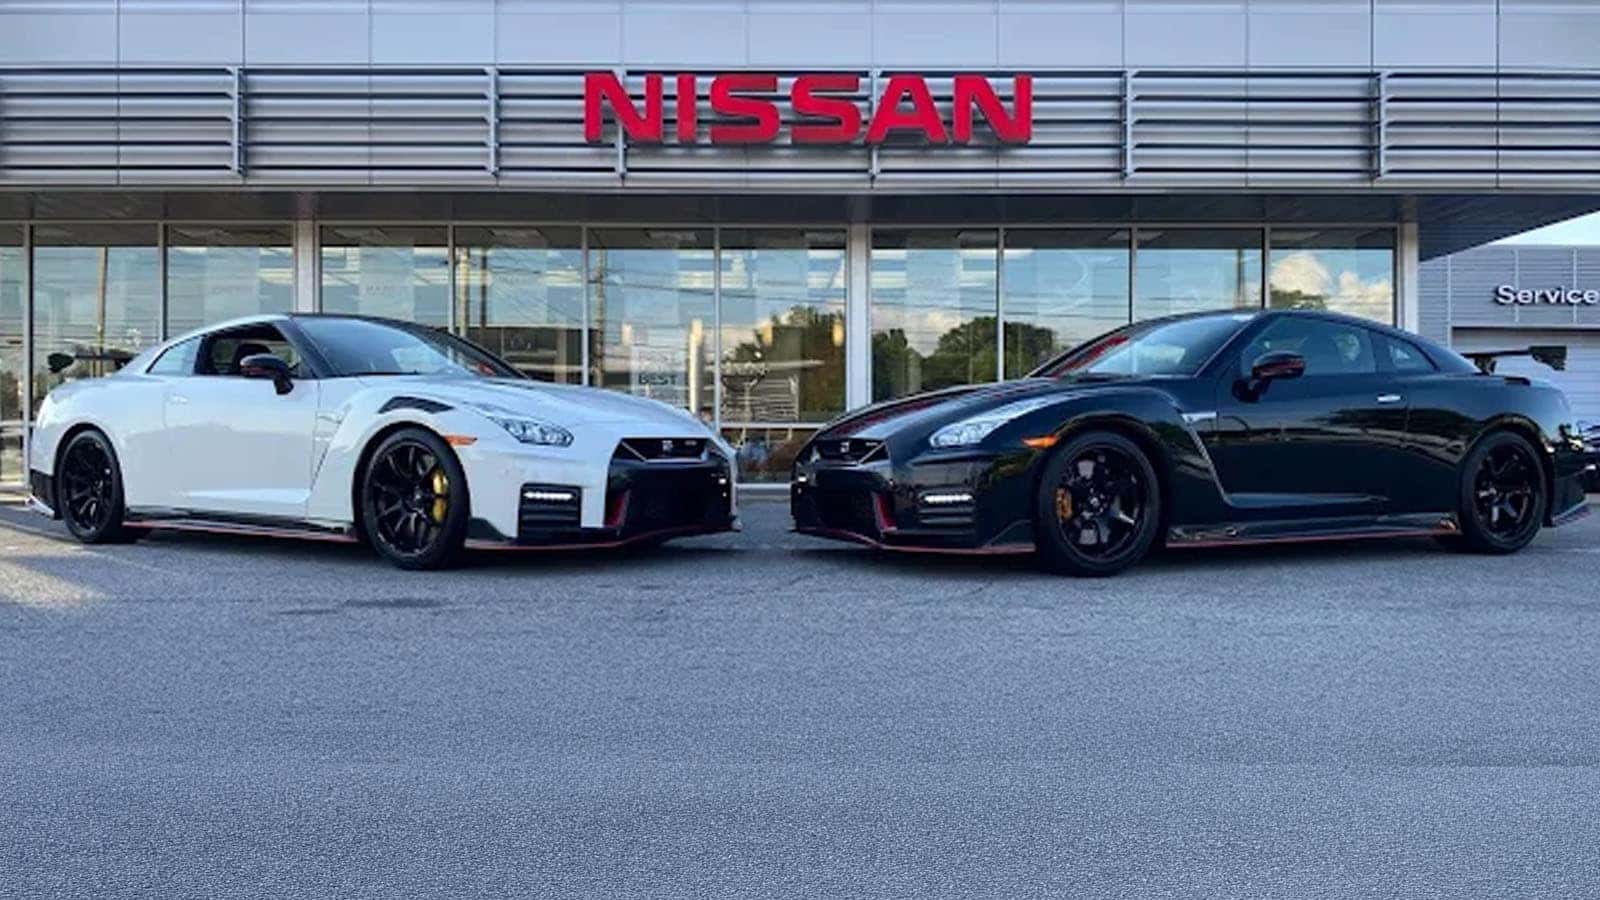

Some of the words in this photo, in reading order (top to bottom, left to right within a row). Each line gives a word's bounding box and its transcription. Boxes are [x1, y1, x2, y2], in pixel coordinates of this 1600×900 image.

[584, 72, 1032, 144] NISSAN
[1496, 284, 1600, 304] Service
[638, 374, 678, 386] BEST
